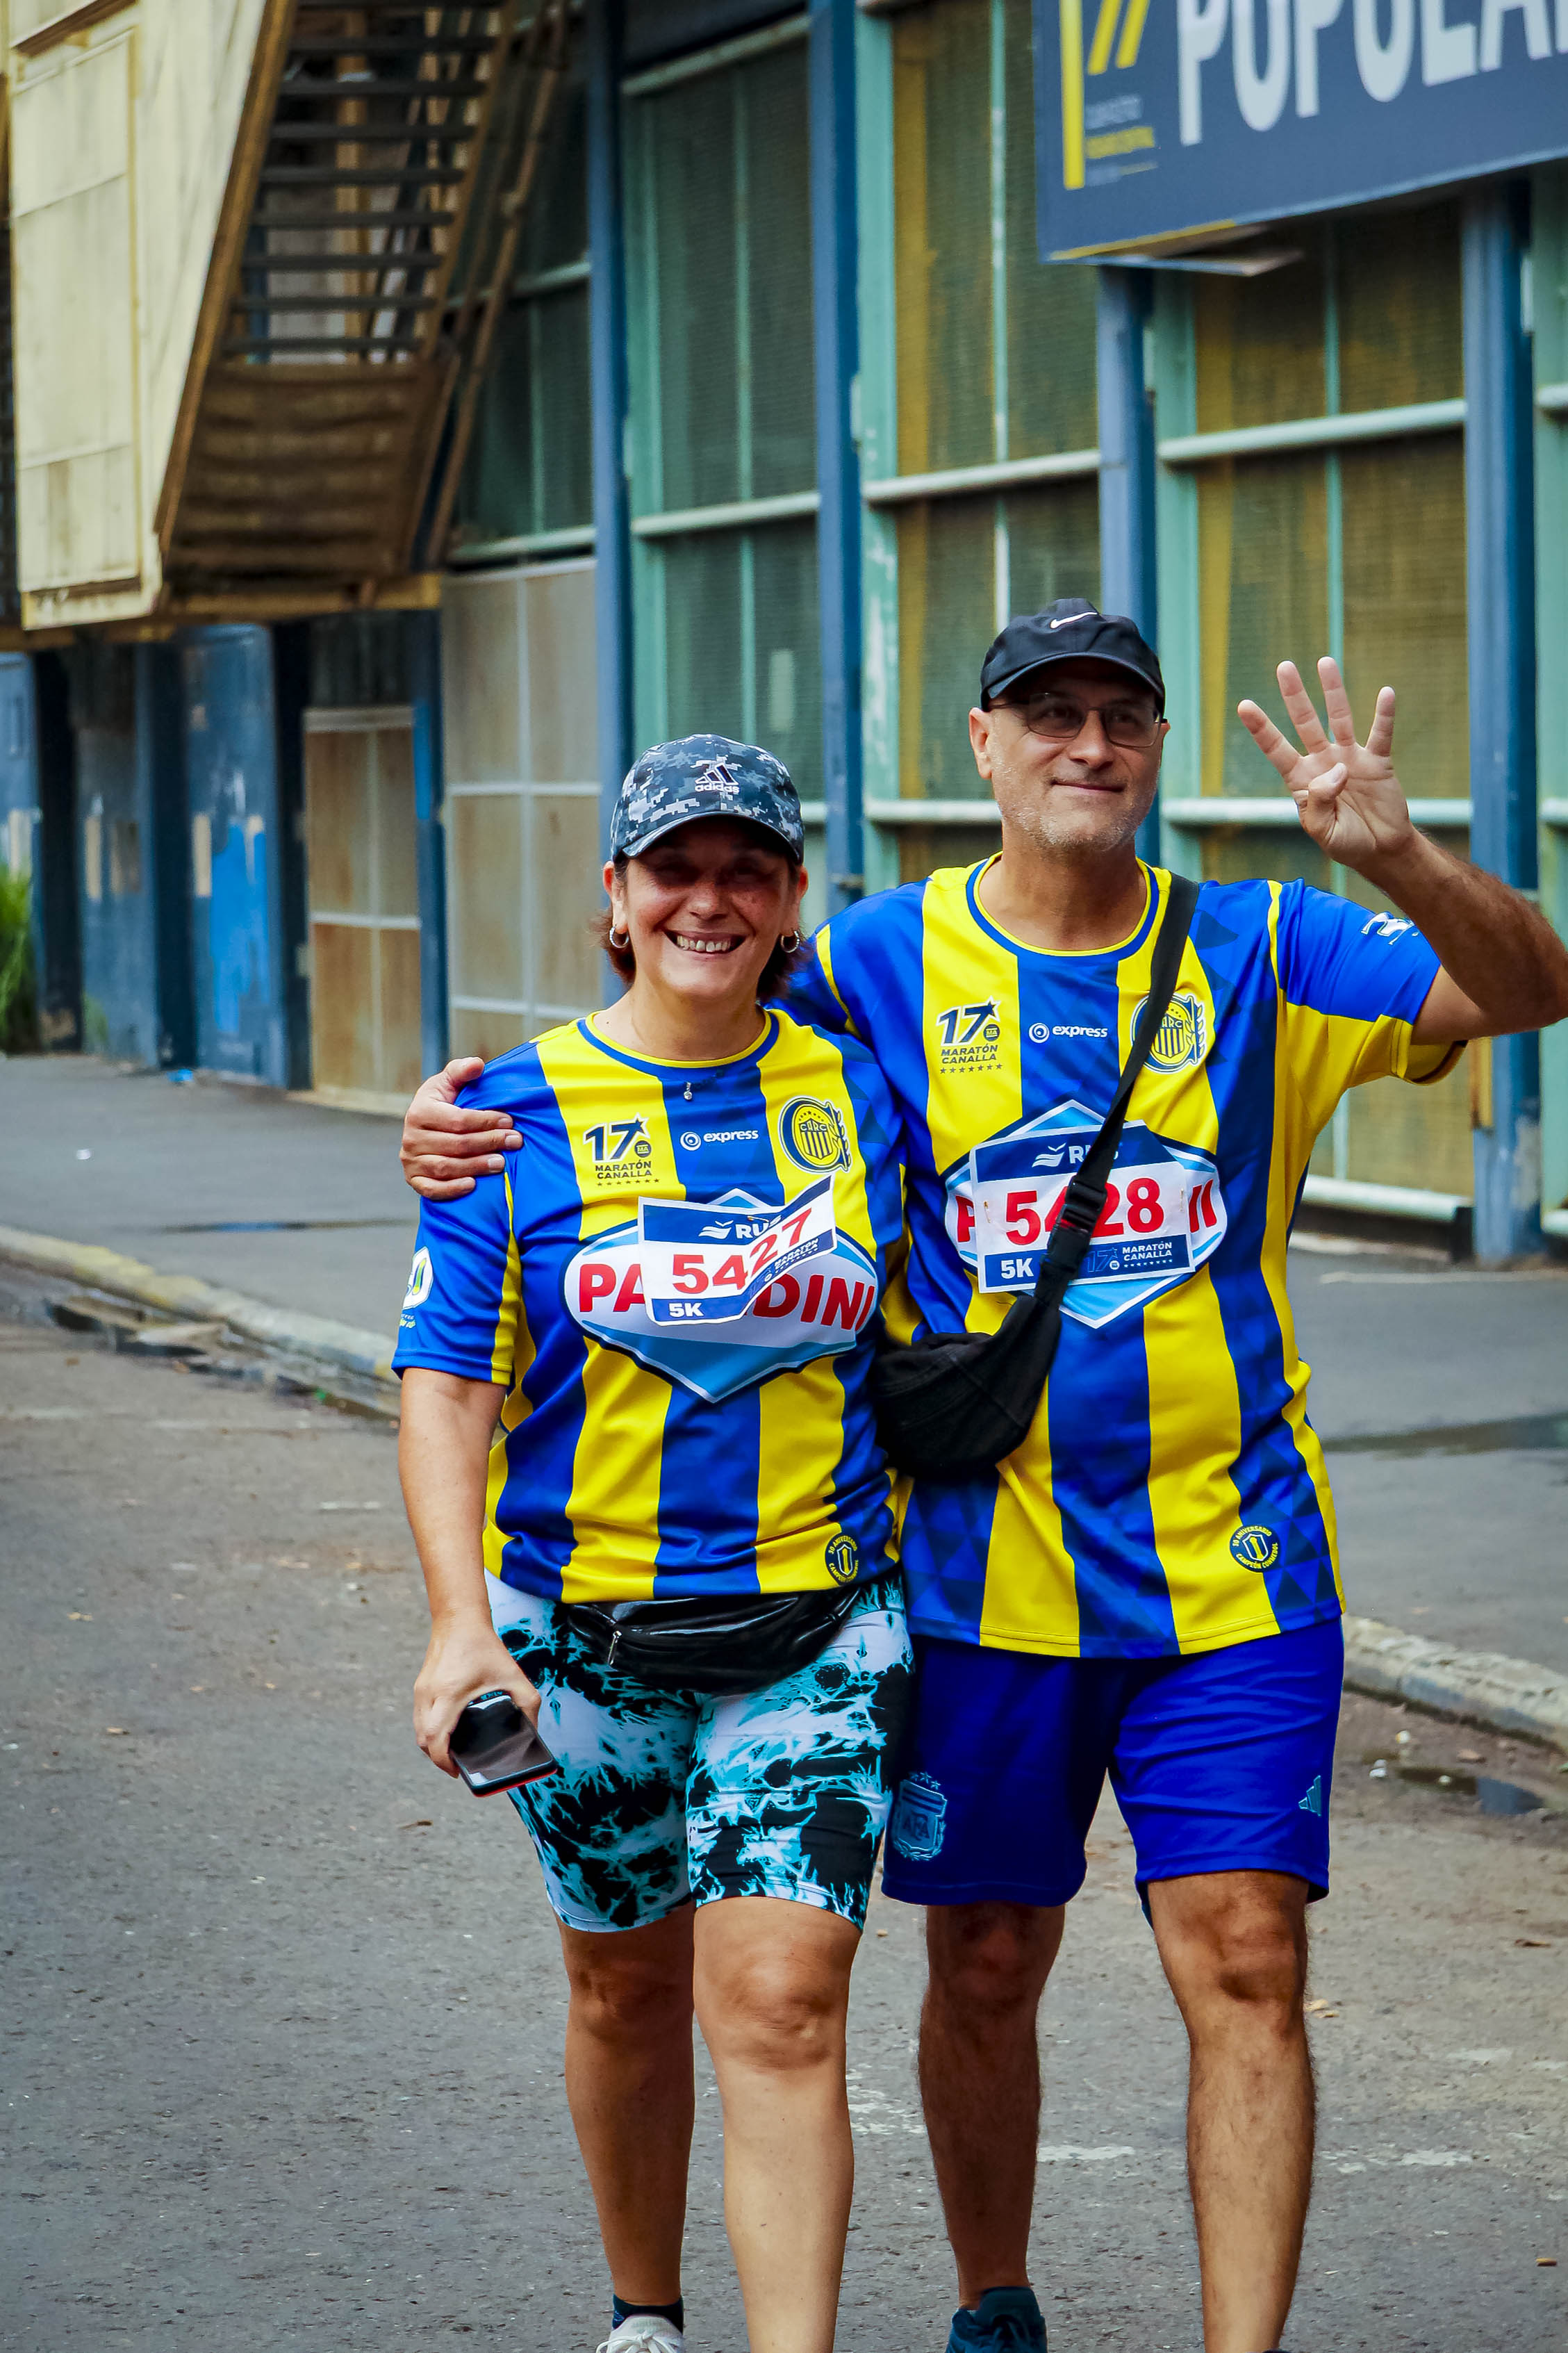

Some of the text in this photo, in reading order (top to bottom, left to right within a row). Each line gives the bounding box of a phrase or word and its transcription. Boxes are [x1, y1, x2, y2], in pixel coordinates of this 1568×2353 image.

[695, 782, 740, 793] adidas
[936, 999, 998, 1044] 17
[1052, 1025, 1108, 1038] express
[941, 1043, 998, 1056] MARATÓN
[941, 1053, 997, 1064] CANALLA
[584, 1116, 649, 1162] 17
[703, 1130, 759, 1143] express
[595, 1159, 652, 1172] MARATÓN
[597, 1170, 652, 1179] CANALLA
[672, 1208, 812, 1294] 5427
[1122, 1240, 1173, 1254] MARATÓN
[1123, 1249, 1173, 1261] CANALLA
[1000, 1257, 1034, 1279] 5K
[669, 1302, 704, 1318] 5K
